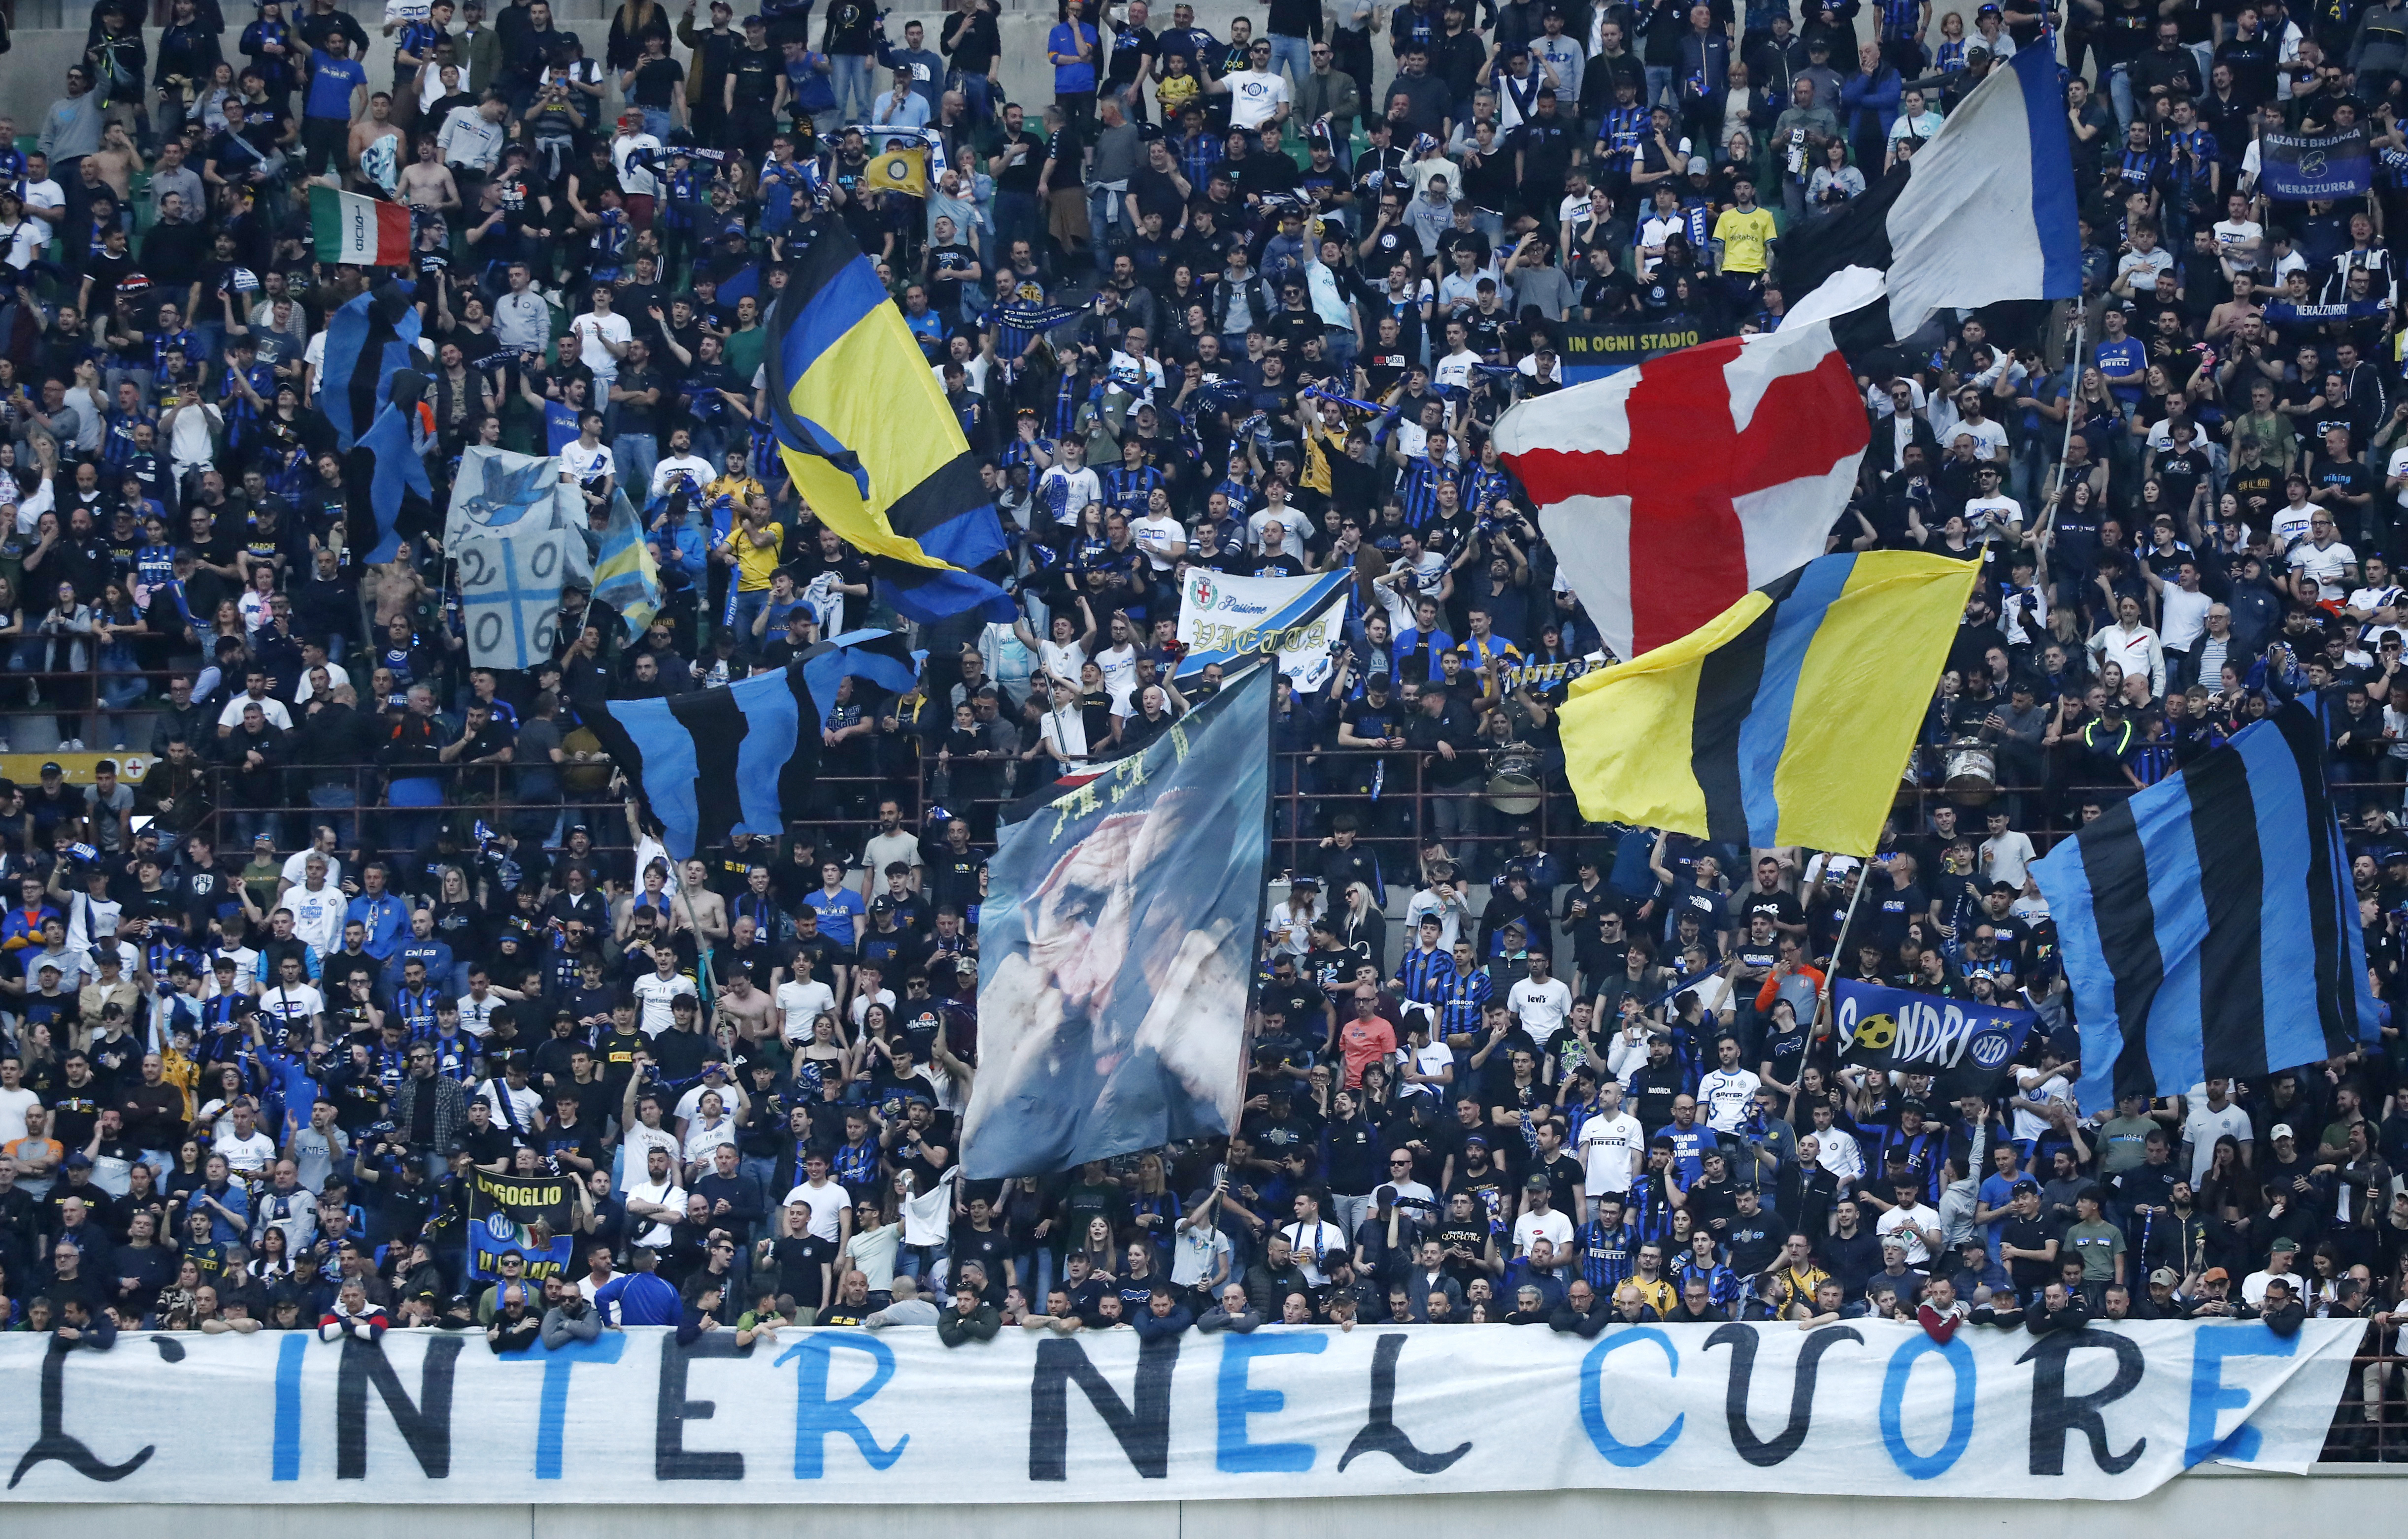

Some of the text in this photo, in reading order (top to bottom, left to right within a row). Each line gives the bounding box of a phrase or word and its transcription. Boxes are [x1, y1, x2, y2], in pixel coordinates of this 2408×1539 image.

[2266, 129, 2361, 148] ALZATE BRIANZA
[2276, 180, 2356, 195] NERAZZURRA
[2296, 303, 2349, 317] NERAZZURRI
[1569, 330, 1699, 353] IN OGNI STADIO
[2100, 358, 2130, 369] PIRELLI
[1202, 372, 1219, 382] NIKE
[2323, 473, 2351, 484] viking
[138, 562, 172, 571] PIRELLI
[1218, 595, 1268, 615] Passione
[1509, 661, 1565, 685] BOYS
[1743, 953, 1774, 964] MONSUMMANO
[1528, 995, 1546, 1003] levi's
[906, 1019, 938, 1029] ellesse
[1590, 1137, 1626, 1146] PIRELLI
[1678, 1134, 1698, 1142] HARD
[2122, 1133, 2142, 1142] 1984
[1678, 1148, 1700, 1157] HOME
[1732, 1231, 1765, 1241] 19 69
[1589, 1247, 1626, 1260] PIRELLI
[1030, 1332, 1472, 1482] NEL
[1580, 1324, 2301, 1480] CUORE
